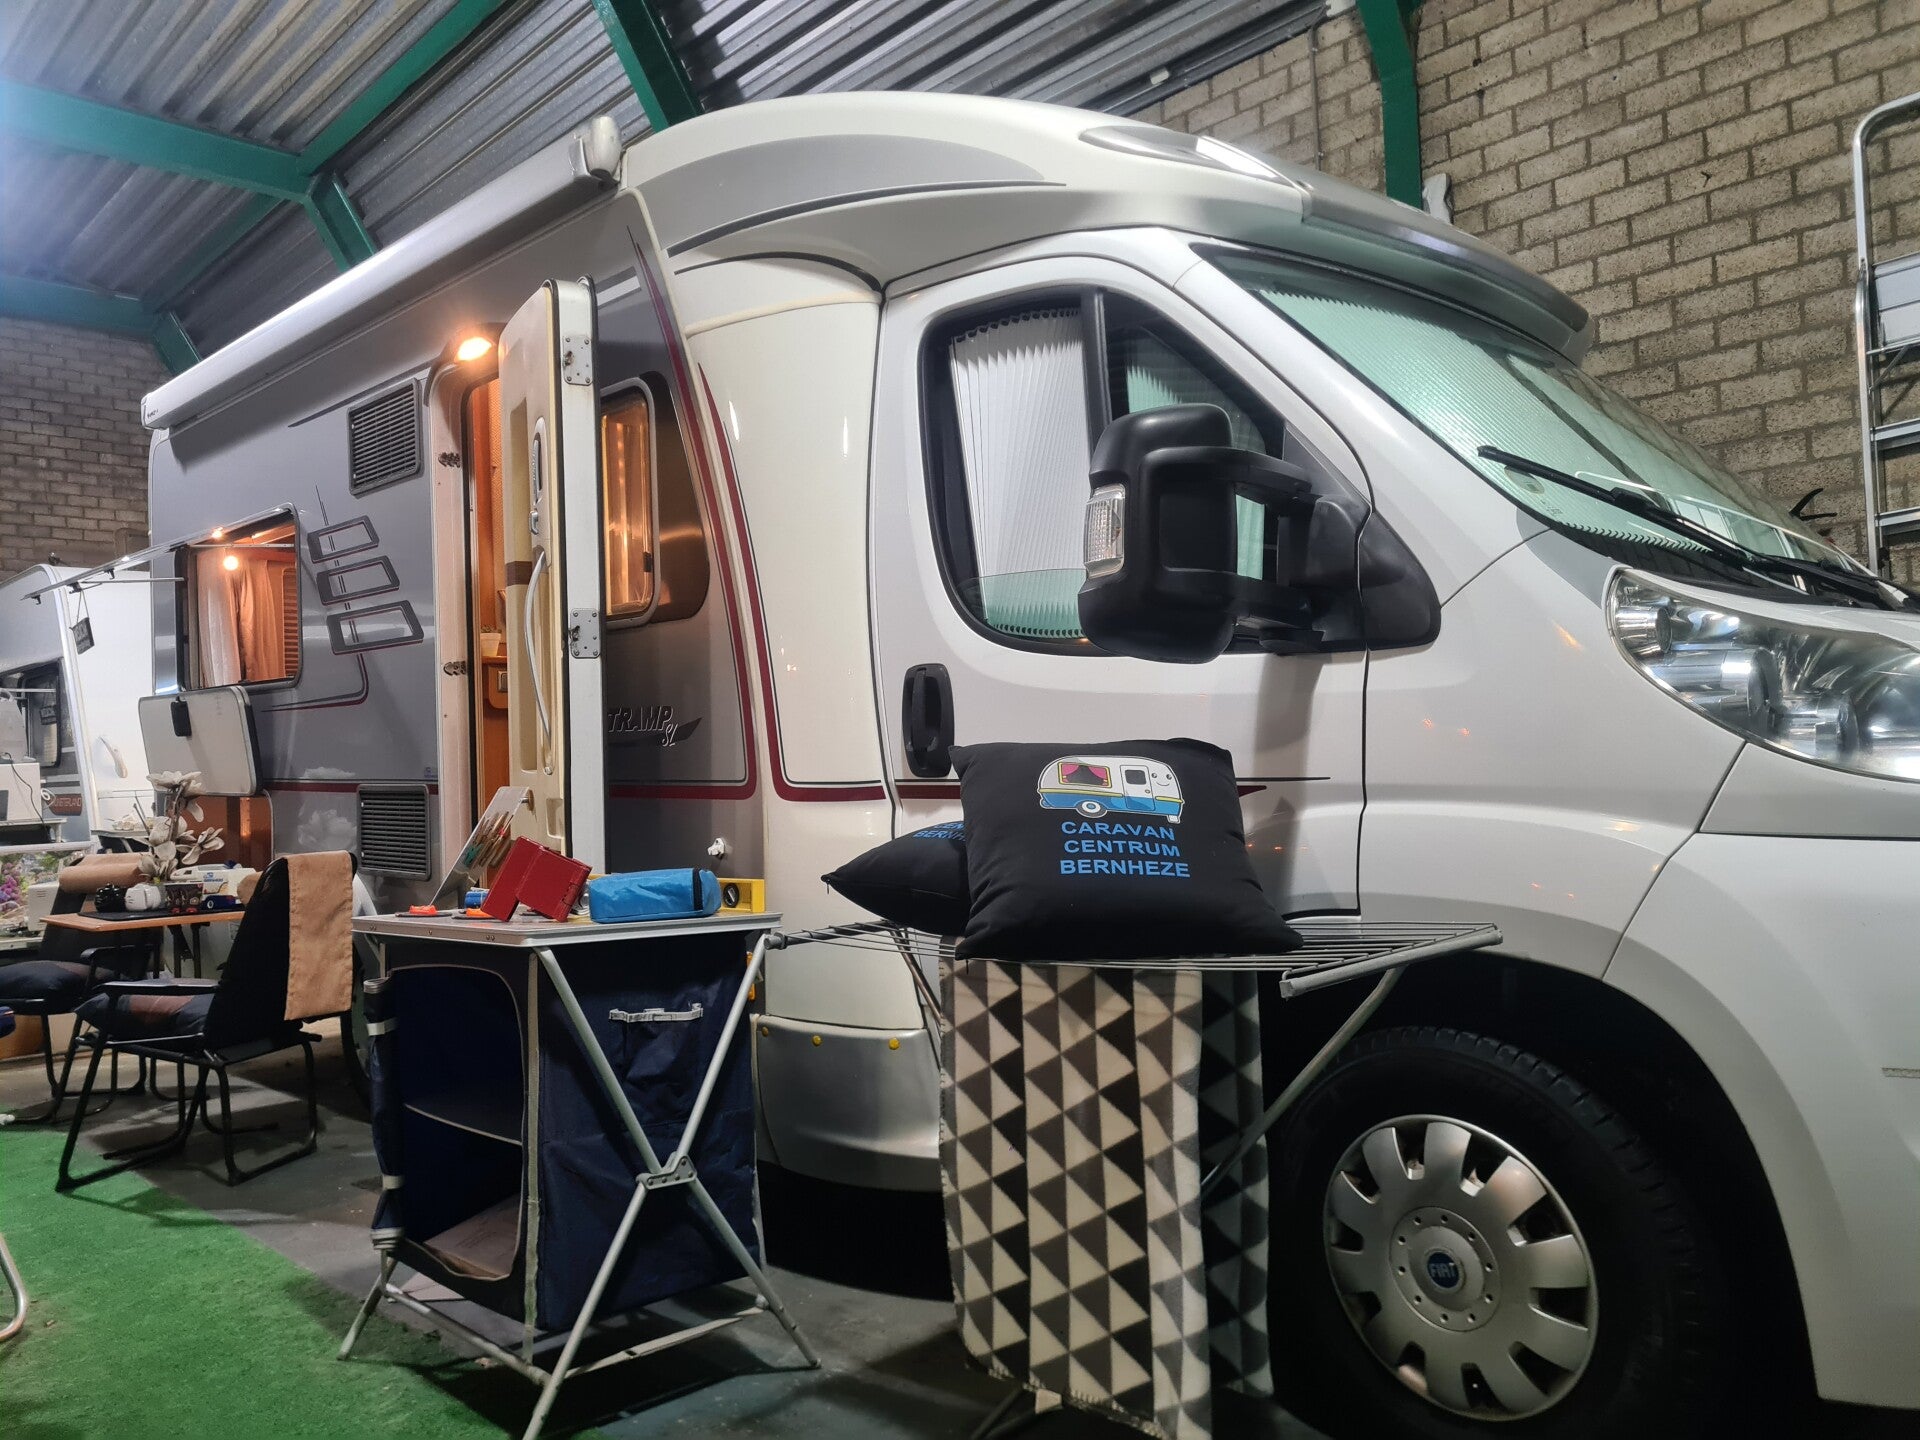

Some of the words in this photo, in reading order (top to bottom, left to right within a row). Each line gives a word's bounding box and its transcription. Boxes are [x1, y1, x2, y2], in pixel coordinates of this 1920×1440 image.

[607, 704, 674, 733] TRAMP
[1061, 821, 1175, 840] CARAVAN
[1063, 840, 1180, 857] CENTRUM
[1060, 859, 1190, 878] BERNHEZE
[1429, 1262, 1456, 1278] FIAT
